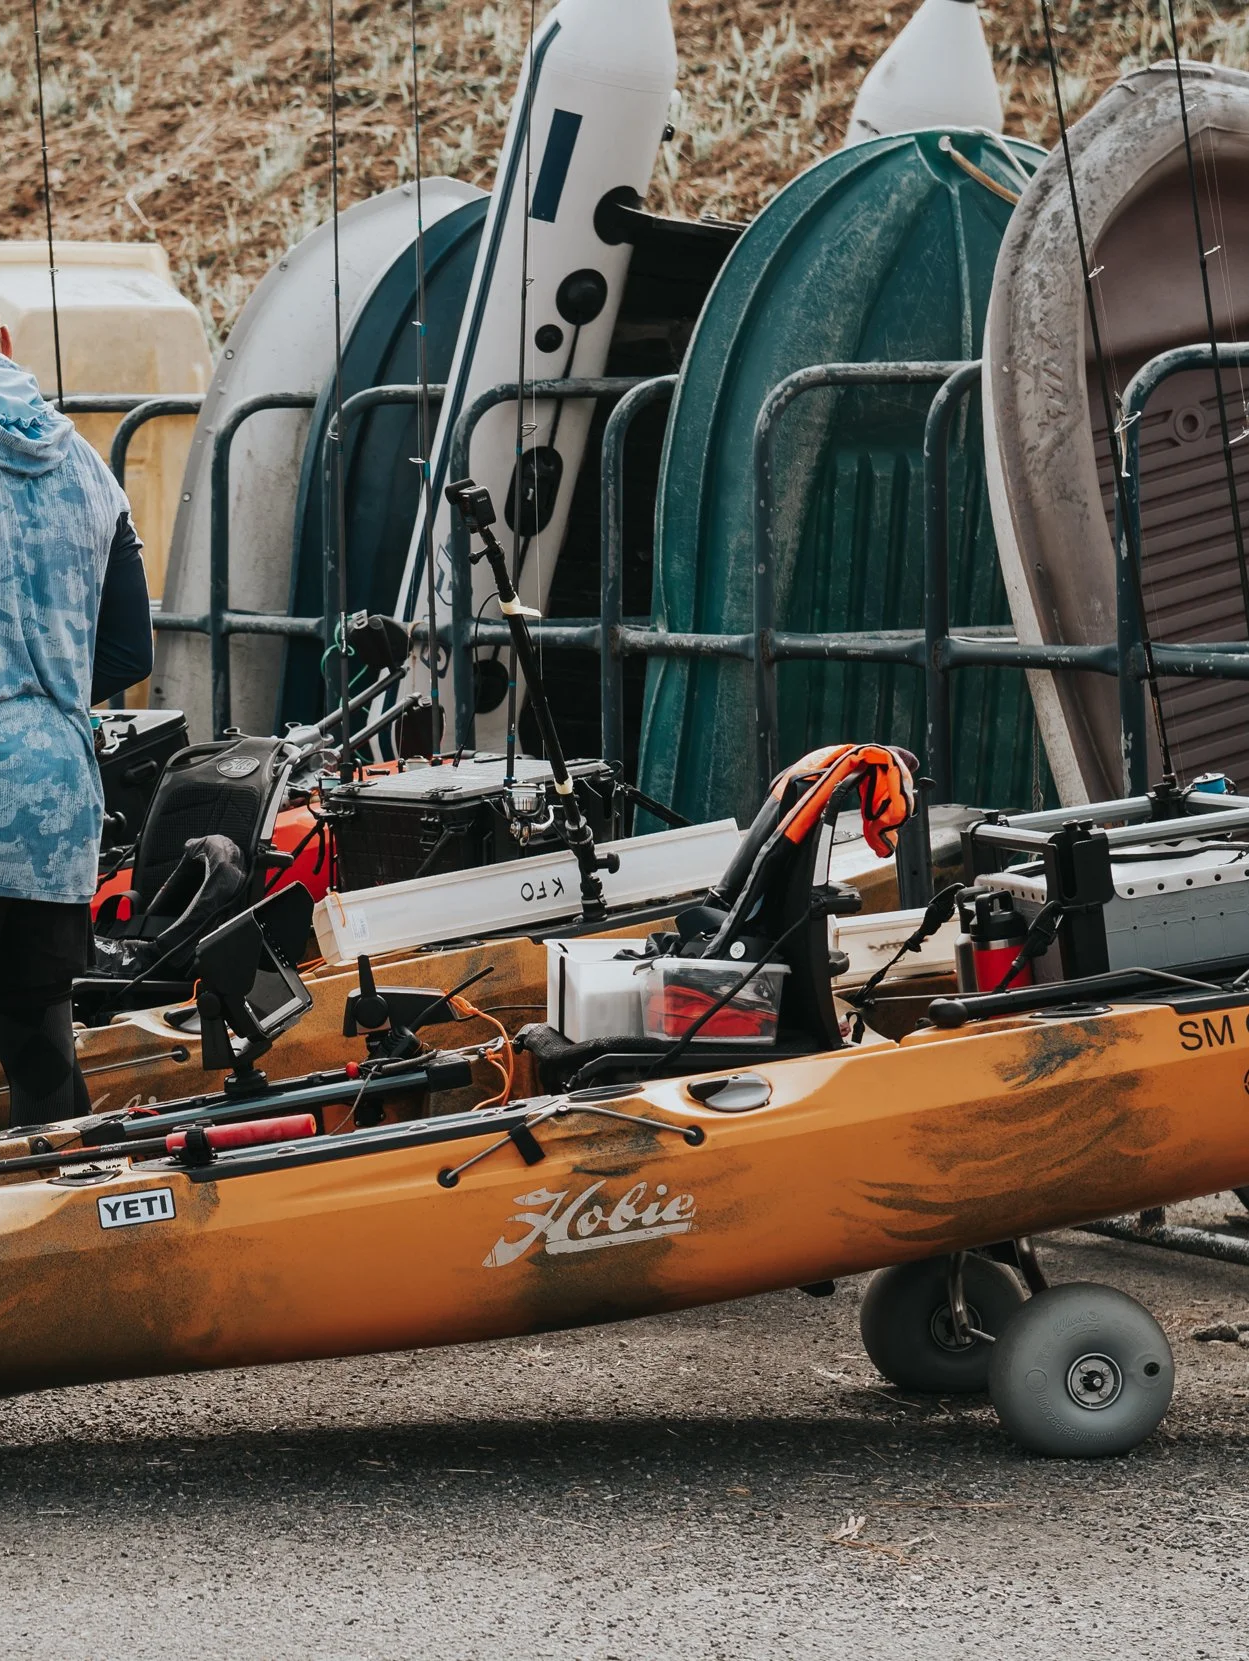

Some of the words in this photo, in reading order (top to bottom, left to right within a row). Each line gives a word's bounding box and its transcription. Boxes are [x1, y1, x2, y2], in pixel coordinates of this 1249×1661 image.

[1178, 1014, 1235, 1051] SM
[102, 1195, 168, 1221] YETI
[482, 1180, 697, 1268] Hobie
